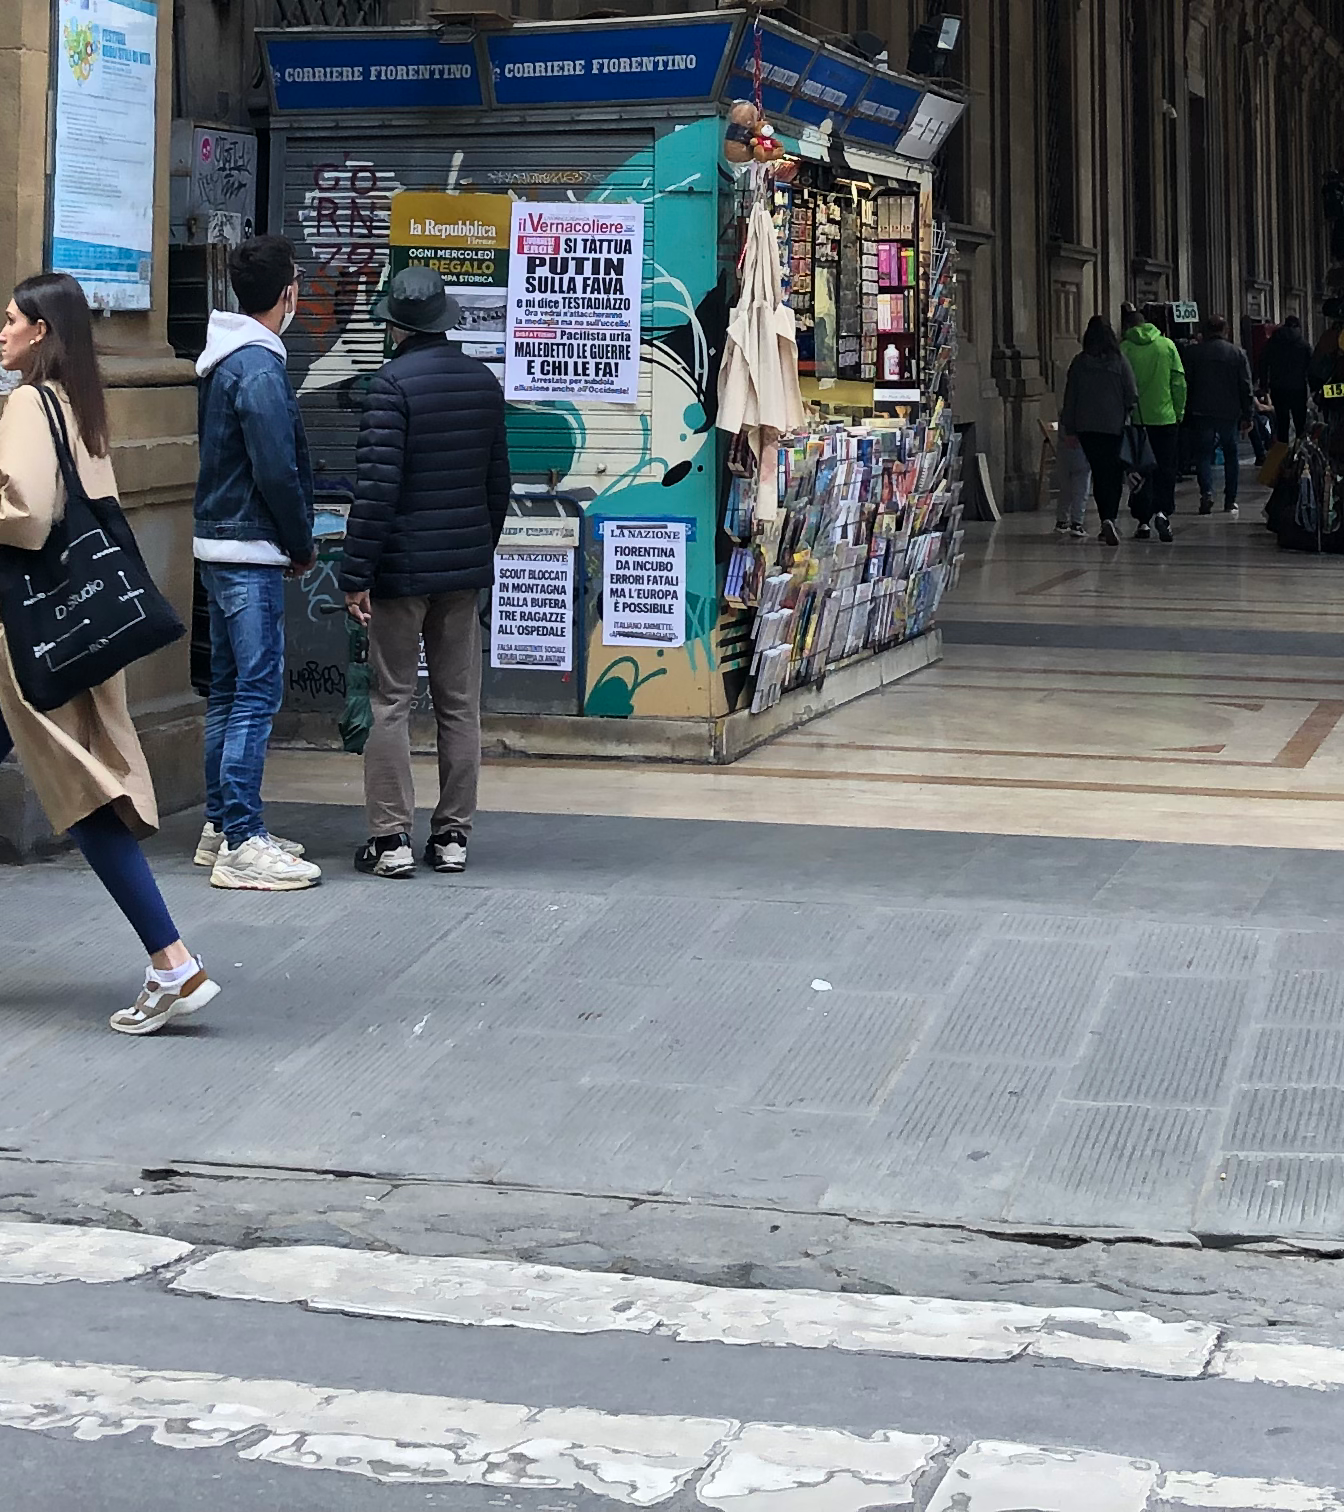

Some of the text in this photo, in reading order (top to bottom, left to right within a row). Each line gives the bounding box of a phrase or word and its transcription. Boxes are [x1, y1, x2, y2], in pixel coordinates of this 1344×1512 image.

[285, 64, 472, 82] CORRIERE FIORENTINO
[505, 54, 697, 78] CORRIERE FIORENTINO
[410, 219, 496, 238] la Repubblica
[518, 213, 624, 234] il Vernacoliere
[409, 249, 435, 257] OGNI
[564, 238, 578, 254] SI
[429, 259, 495, 274] REGALO
[526, 256, 625, 276] PUTIN
[459, 275, 493, 283] STORICA
[525, 276, 625, 295] SULLA FAVA
[516, 299, 523, 308] e
[525, 298, 535, 308] ni
[538, 298, 559, 309] dice
[1175, 304, 1197, 320] 5,00
[515, 317, 523, 325] la
[525, 317, 559, 326] medaglia
[560, 330, 631, 342] Pacifista urla
[514, 342, 574, 359] MALEDETTO
[576, 343, 588, 359] LE
[590, 344, 631, 360] GUERRE
[526, 360, 619, 377] E CHI LE FA!
[531, 376, 567, 384] Arrestato
[584, 377, 614, 385] subdola
[610, 529, 680, 540] LA NAZIONE
[500, 553, 569, 563] LA NAZIONE
[614, 545, 675, 558] FIORENTINA
[616, 560, 673, 572] DA INCUBO
[499, 568, 568, 582] SCOUT BLOCCATI
[610, 573, 679, 587] ERRORI FATALI
[67, 579, 105, 611] studio
[499, 582, 567, 596] IN MONTAGNA
[609, 587, 678, 600] MA L'EUROPA
[498, 596, 566, 610] DALLA BUFERA
[614, 599, 674, 614] È POSSIBILE
[498, 610, 566, 623] TRE RAGAZZE
[497, 624, 566, 637] ALL'OSPEDALE
[614, 621, 642, 630] ITALIANO
[544, 645, 566, 654] SOCIALE
